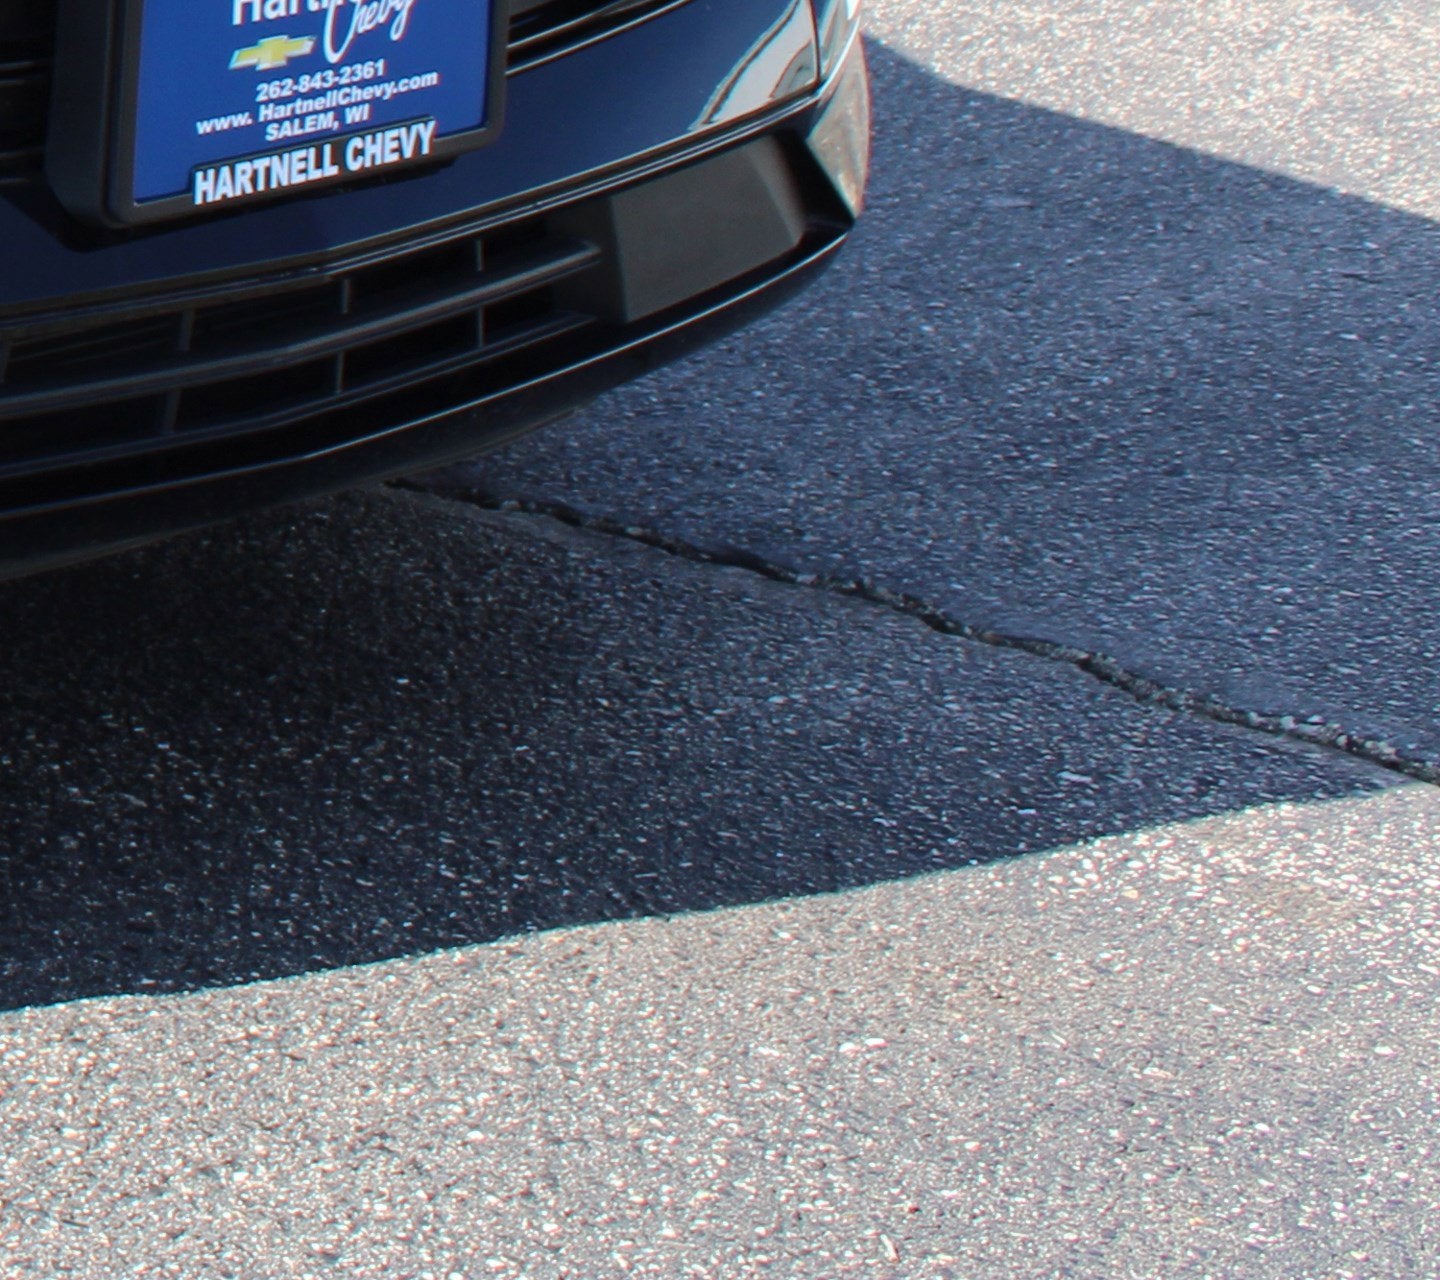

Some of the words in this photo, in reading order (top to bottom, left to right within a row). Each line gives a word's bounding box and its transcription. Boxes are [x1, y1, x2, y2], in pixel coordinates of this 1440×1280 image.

[196, 111, 253, 135] www.
[257, 71, 439, 123] HartnellChevy.com
[255, 58, 386, 102] 262-843-2361
[265, 111, 339, 141] SALEM,
[344, 103, 371, 125] WI
[193, 143, 340, 205] HARTNELL
[344, 119, 437, 171] CHEVY
